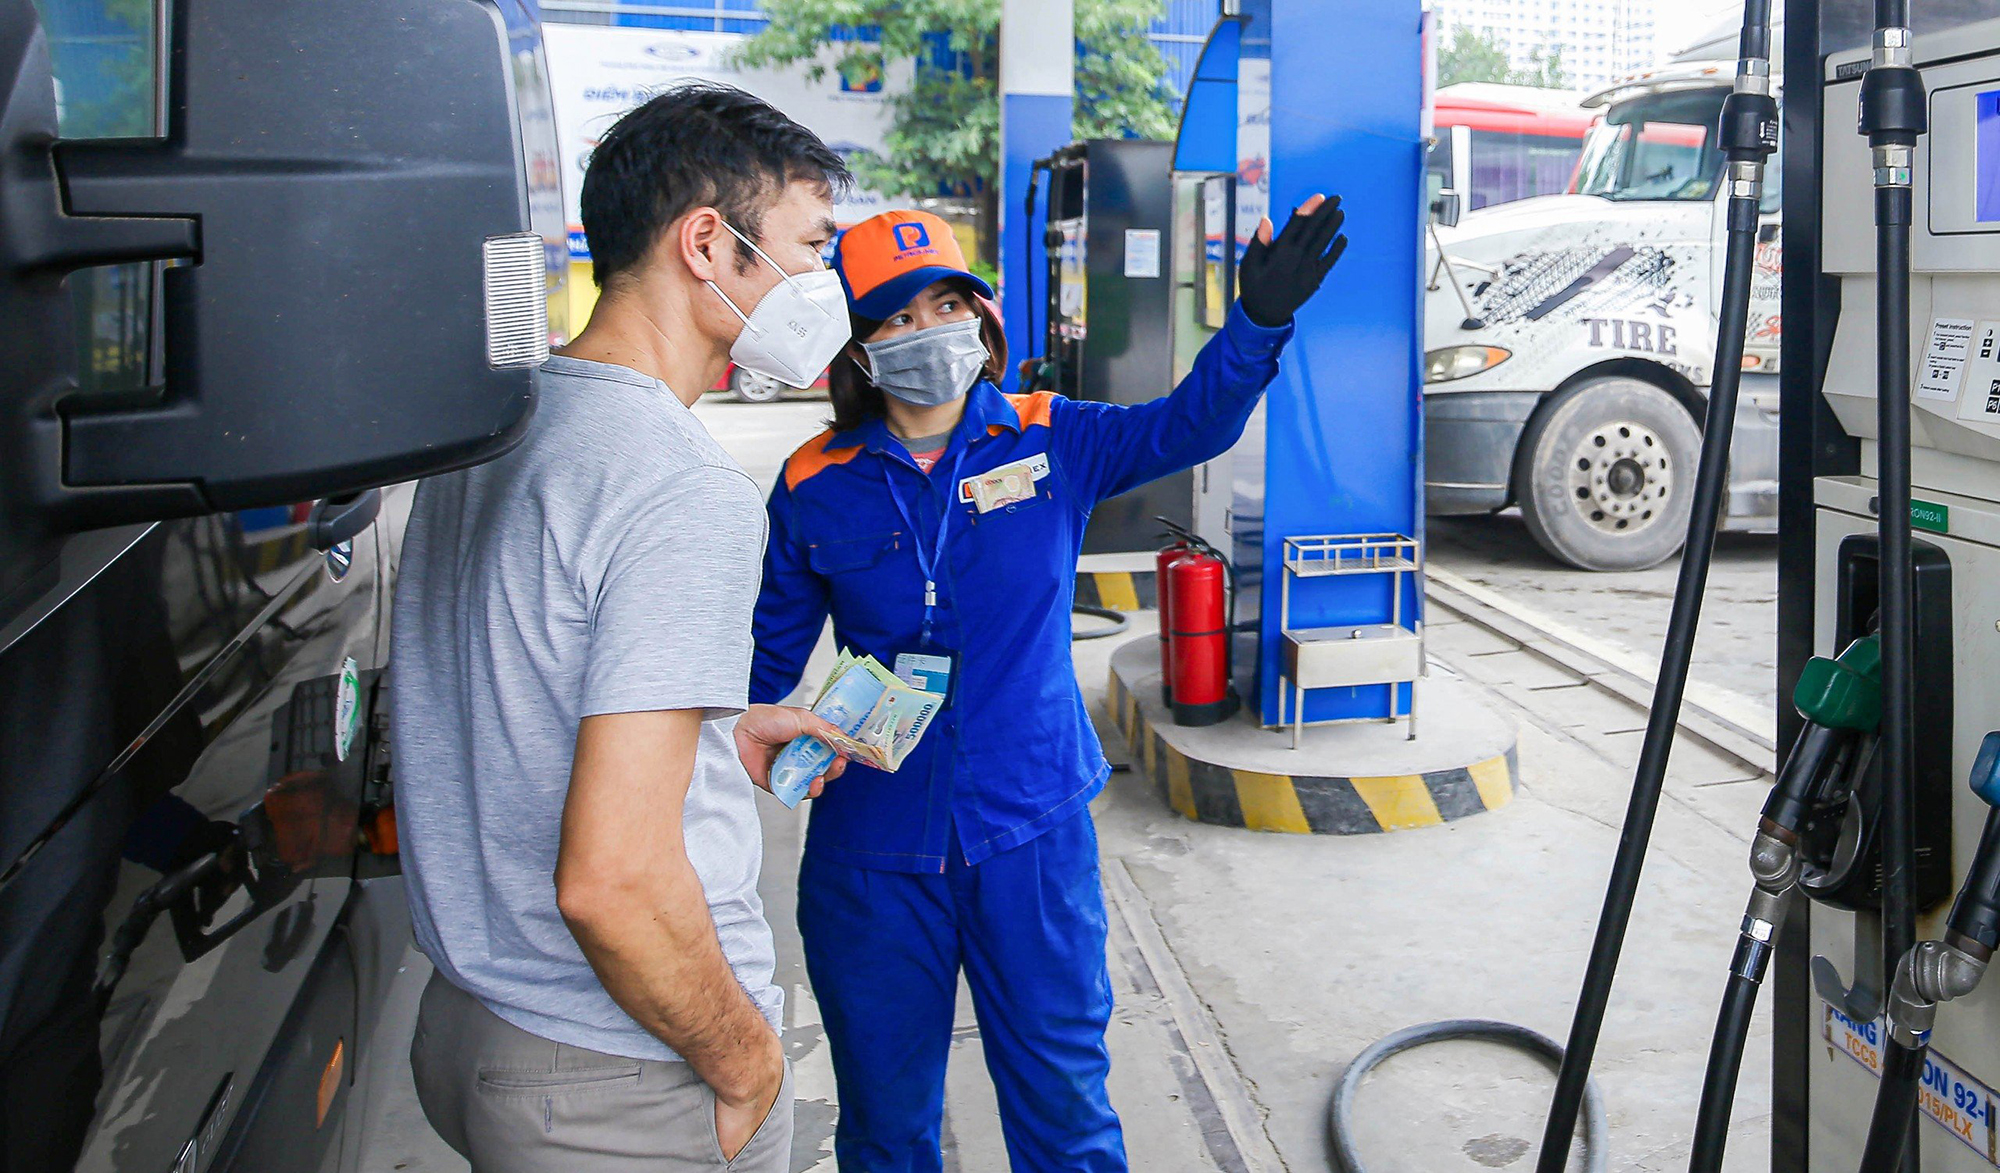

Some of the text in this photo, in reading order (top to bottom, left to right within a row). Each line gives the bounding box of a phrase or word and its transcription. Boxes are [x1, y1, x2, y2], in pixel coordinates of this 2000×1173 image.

[1837, 61, 1872, 77] TATSUN
[1583, 318, 1677, 355] TIRE
[1032, 462, 1047, 473] EX
[905, 703, 933, 740] 500000
[1845, 1032, 1877, 1069] TCCS
[1921, 1058, 1948, 1098] ON
[1918, 1085, 1973, 1142] 015/PLX
